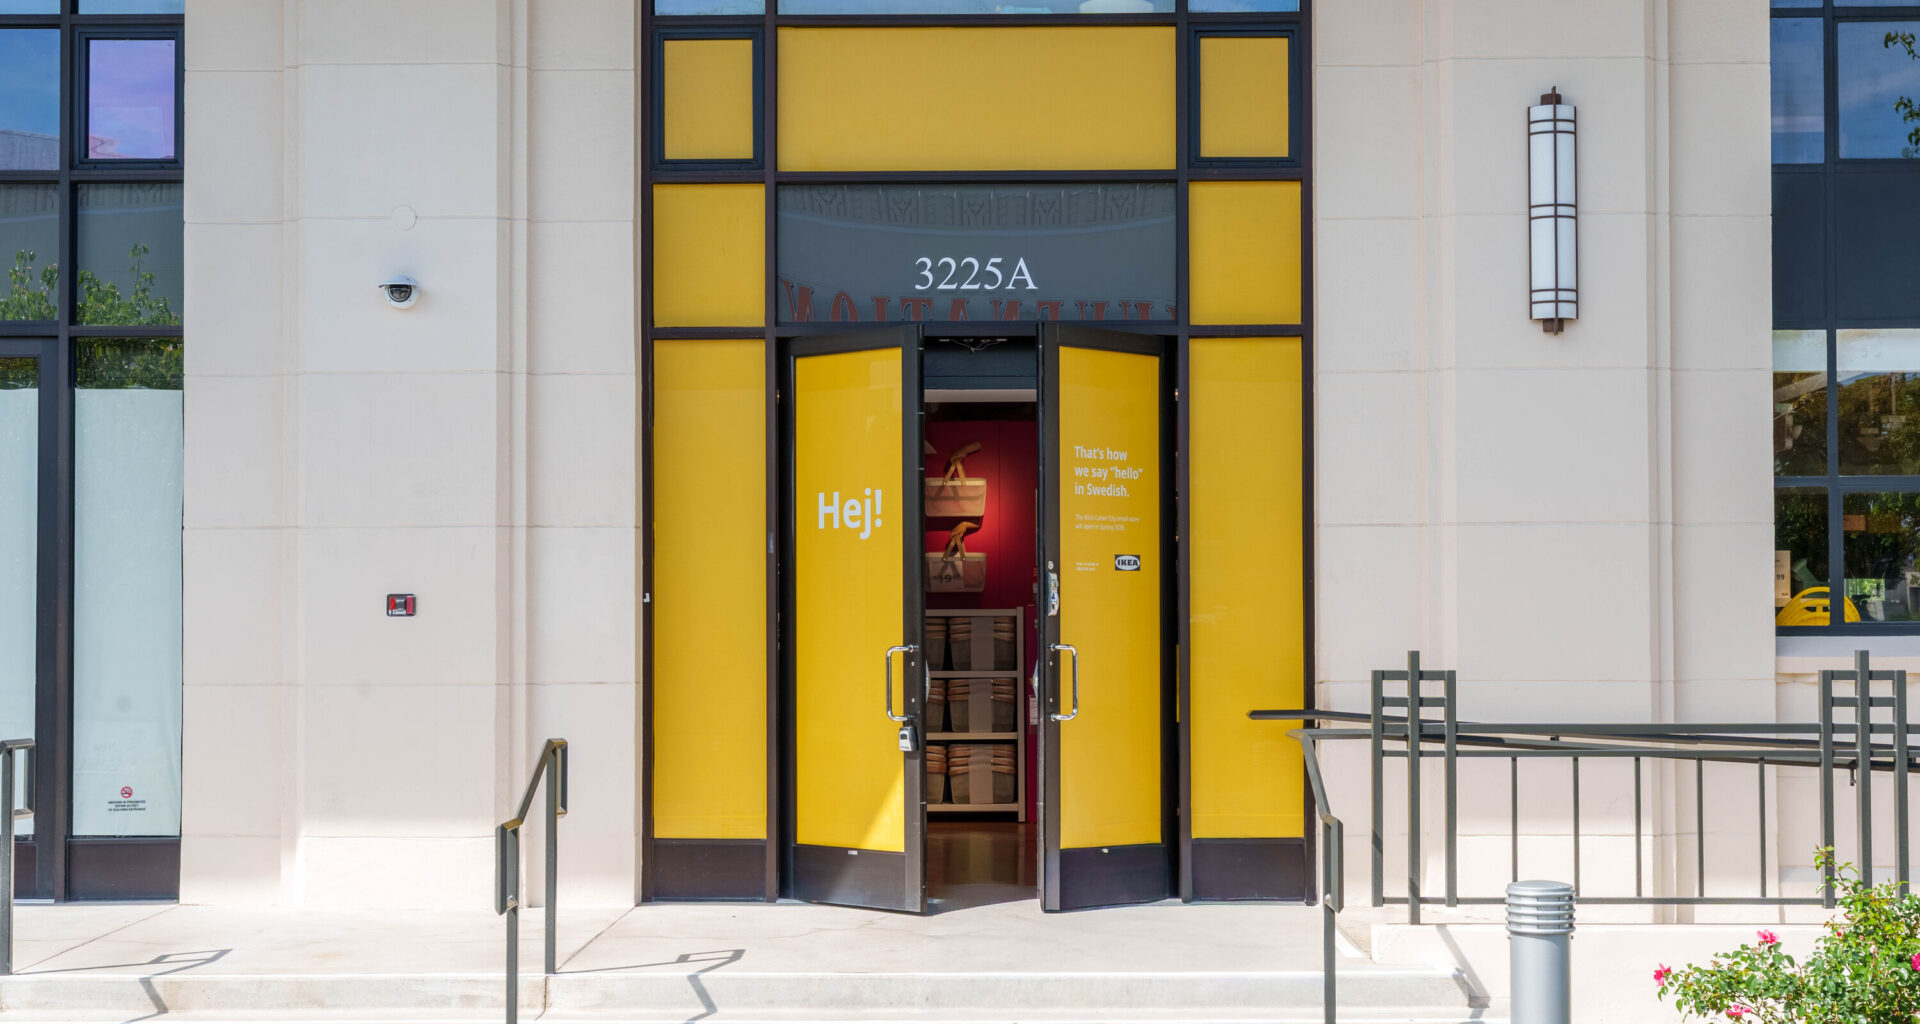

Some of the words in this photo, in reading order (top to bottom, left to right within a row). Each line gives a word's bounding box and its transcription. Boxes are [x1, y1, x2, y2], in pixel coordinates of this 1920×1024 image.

[914, 257, 1038, 290] 3225A
[1074, 445, 1104, 460] That's
[1106, 447, 1128, 461] how
[1074, 467, 1089, 477] we
[1091, 467, 1108, 482] say
[1074, 482, 1085, 495] in
[1087, 483, 1130, 497] Swedish.
[818, 488, 882, 540] Hej!
[1117, 558, 1139, 568] IKEA
